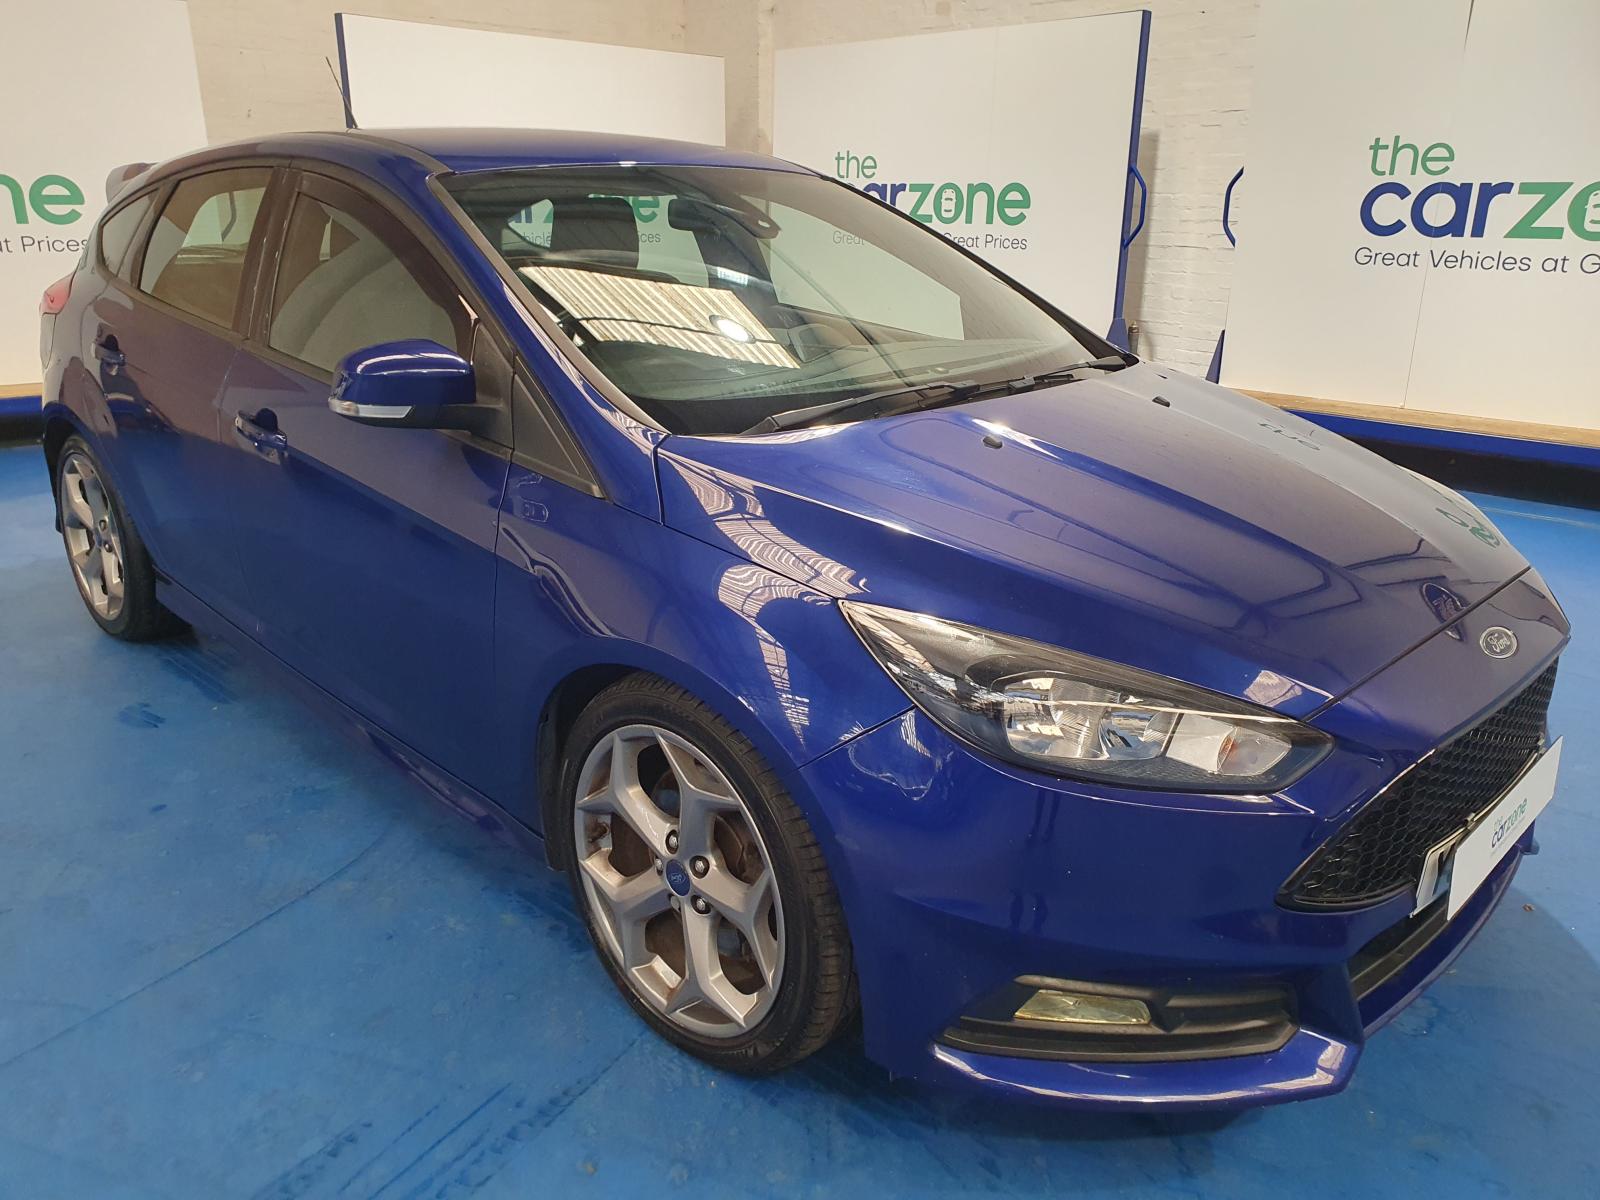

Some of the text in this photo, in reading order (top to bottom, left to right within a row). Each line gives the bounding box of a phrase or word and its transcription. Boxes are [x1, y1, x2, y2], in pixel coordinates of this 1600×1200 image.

[835, 150, 877, 179] the
[1369, 135, 1455, 176] the
[848, 182, 1031, 226] arzone
[985, 233, 1028, 250] Prices
[1354, 246, 1420, 268] Great
[1429, 249, 1532, 272] Vehicles
[1541, 255, 1570, 273] at
